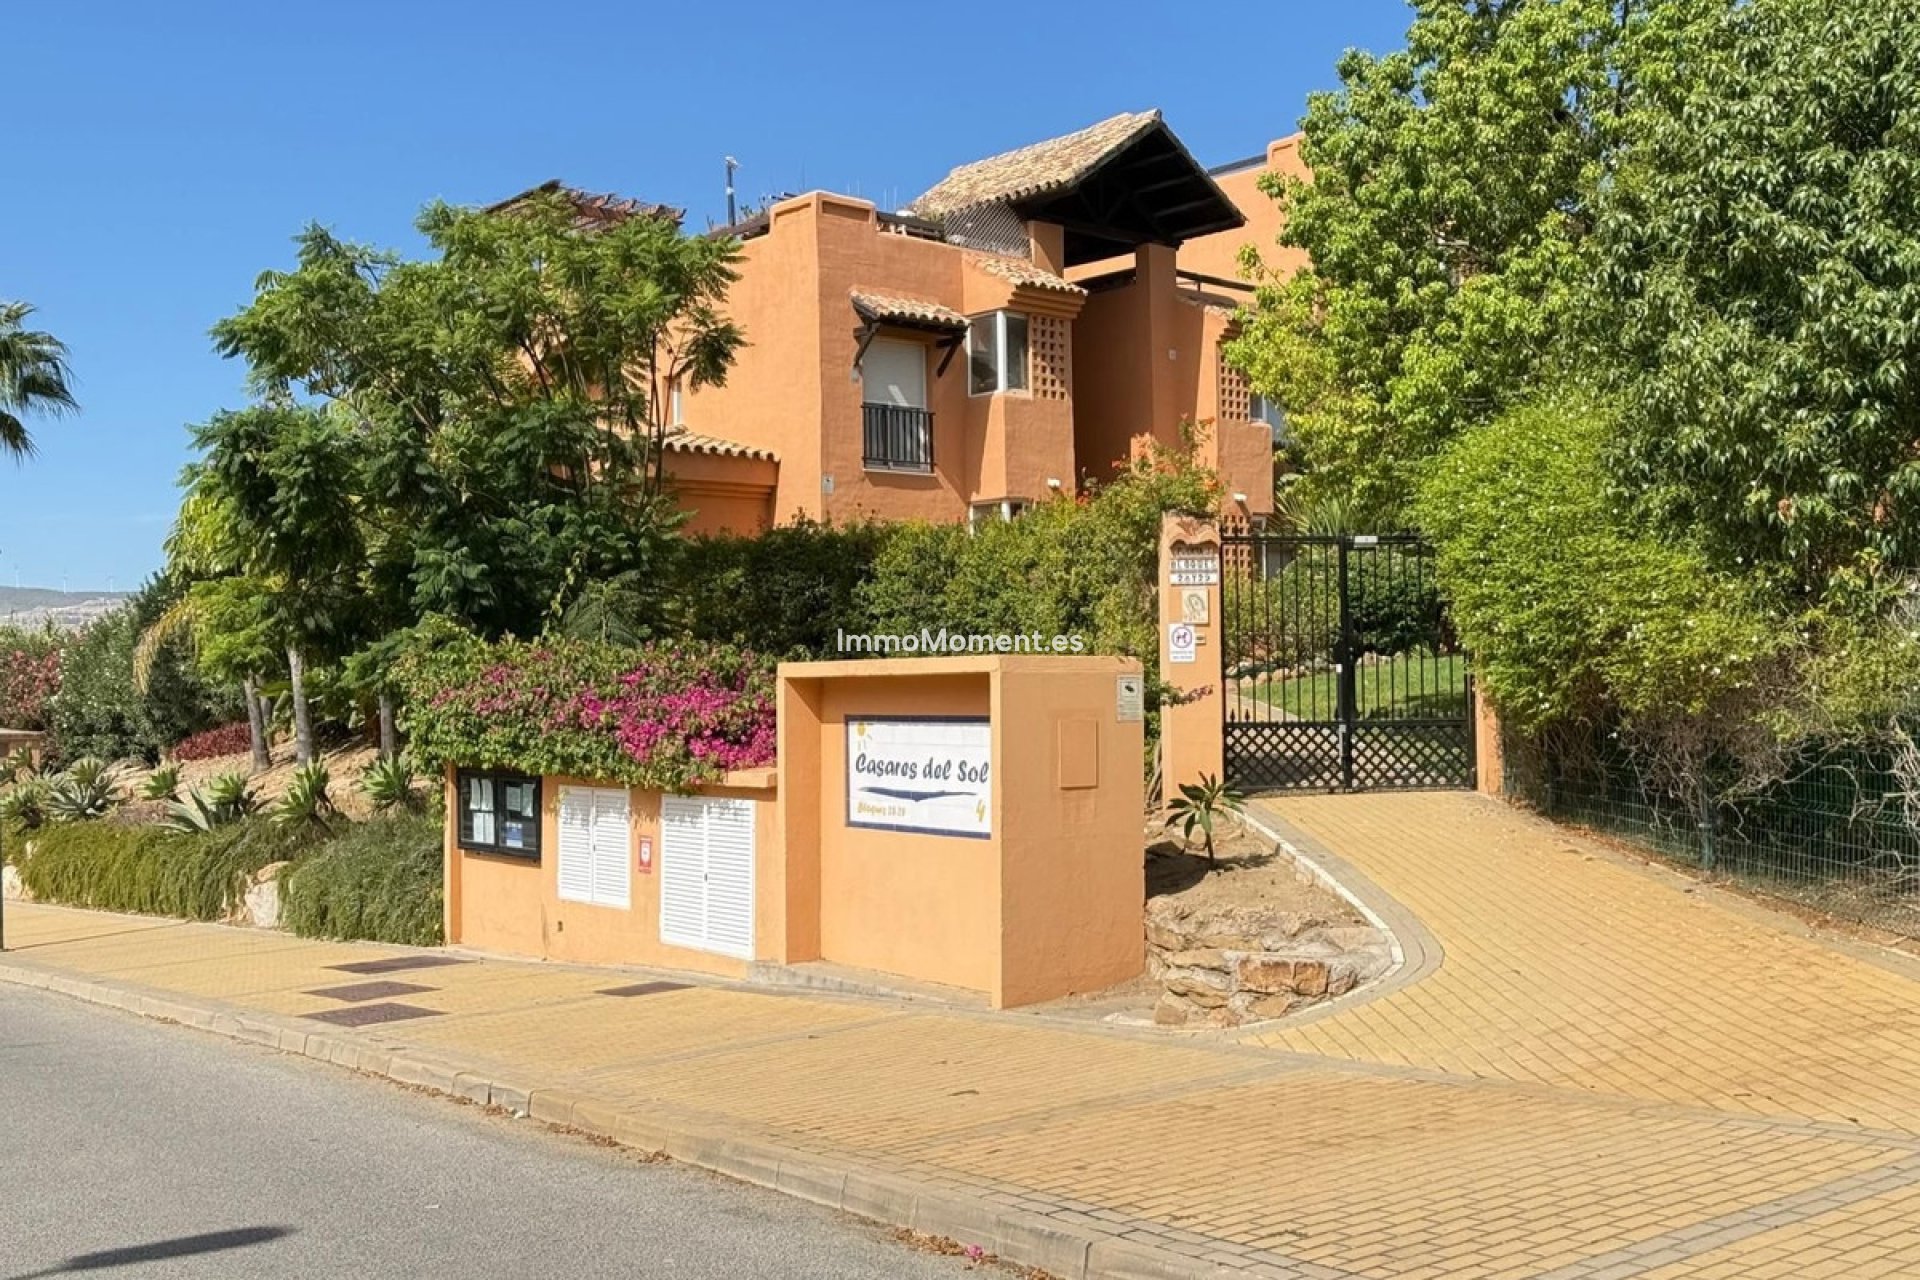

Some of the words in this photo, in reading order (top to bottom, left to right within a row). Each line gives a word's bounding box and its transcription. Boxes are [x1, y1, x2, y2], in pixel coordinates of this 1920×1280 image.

[855, 752, 918, 780] Casares
[922, 756, 952, 780] del
[957, 759, 990, 783] Sol
